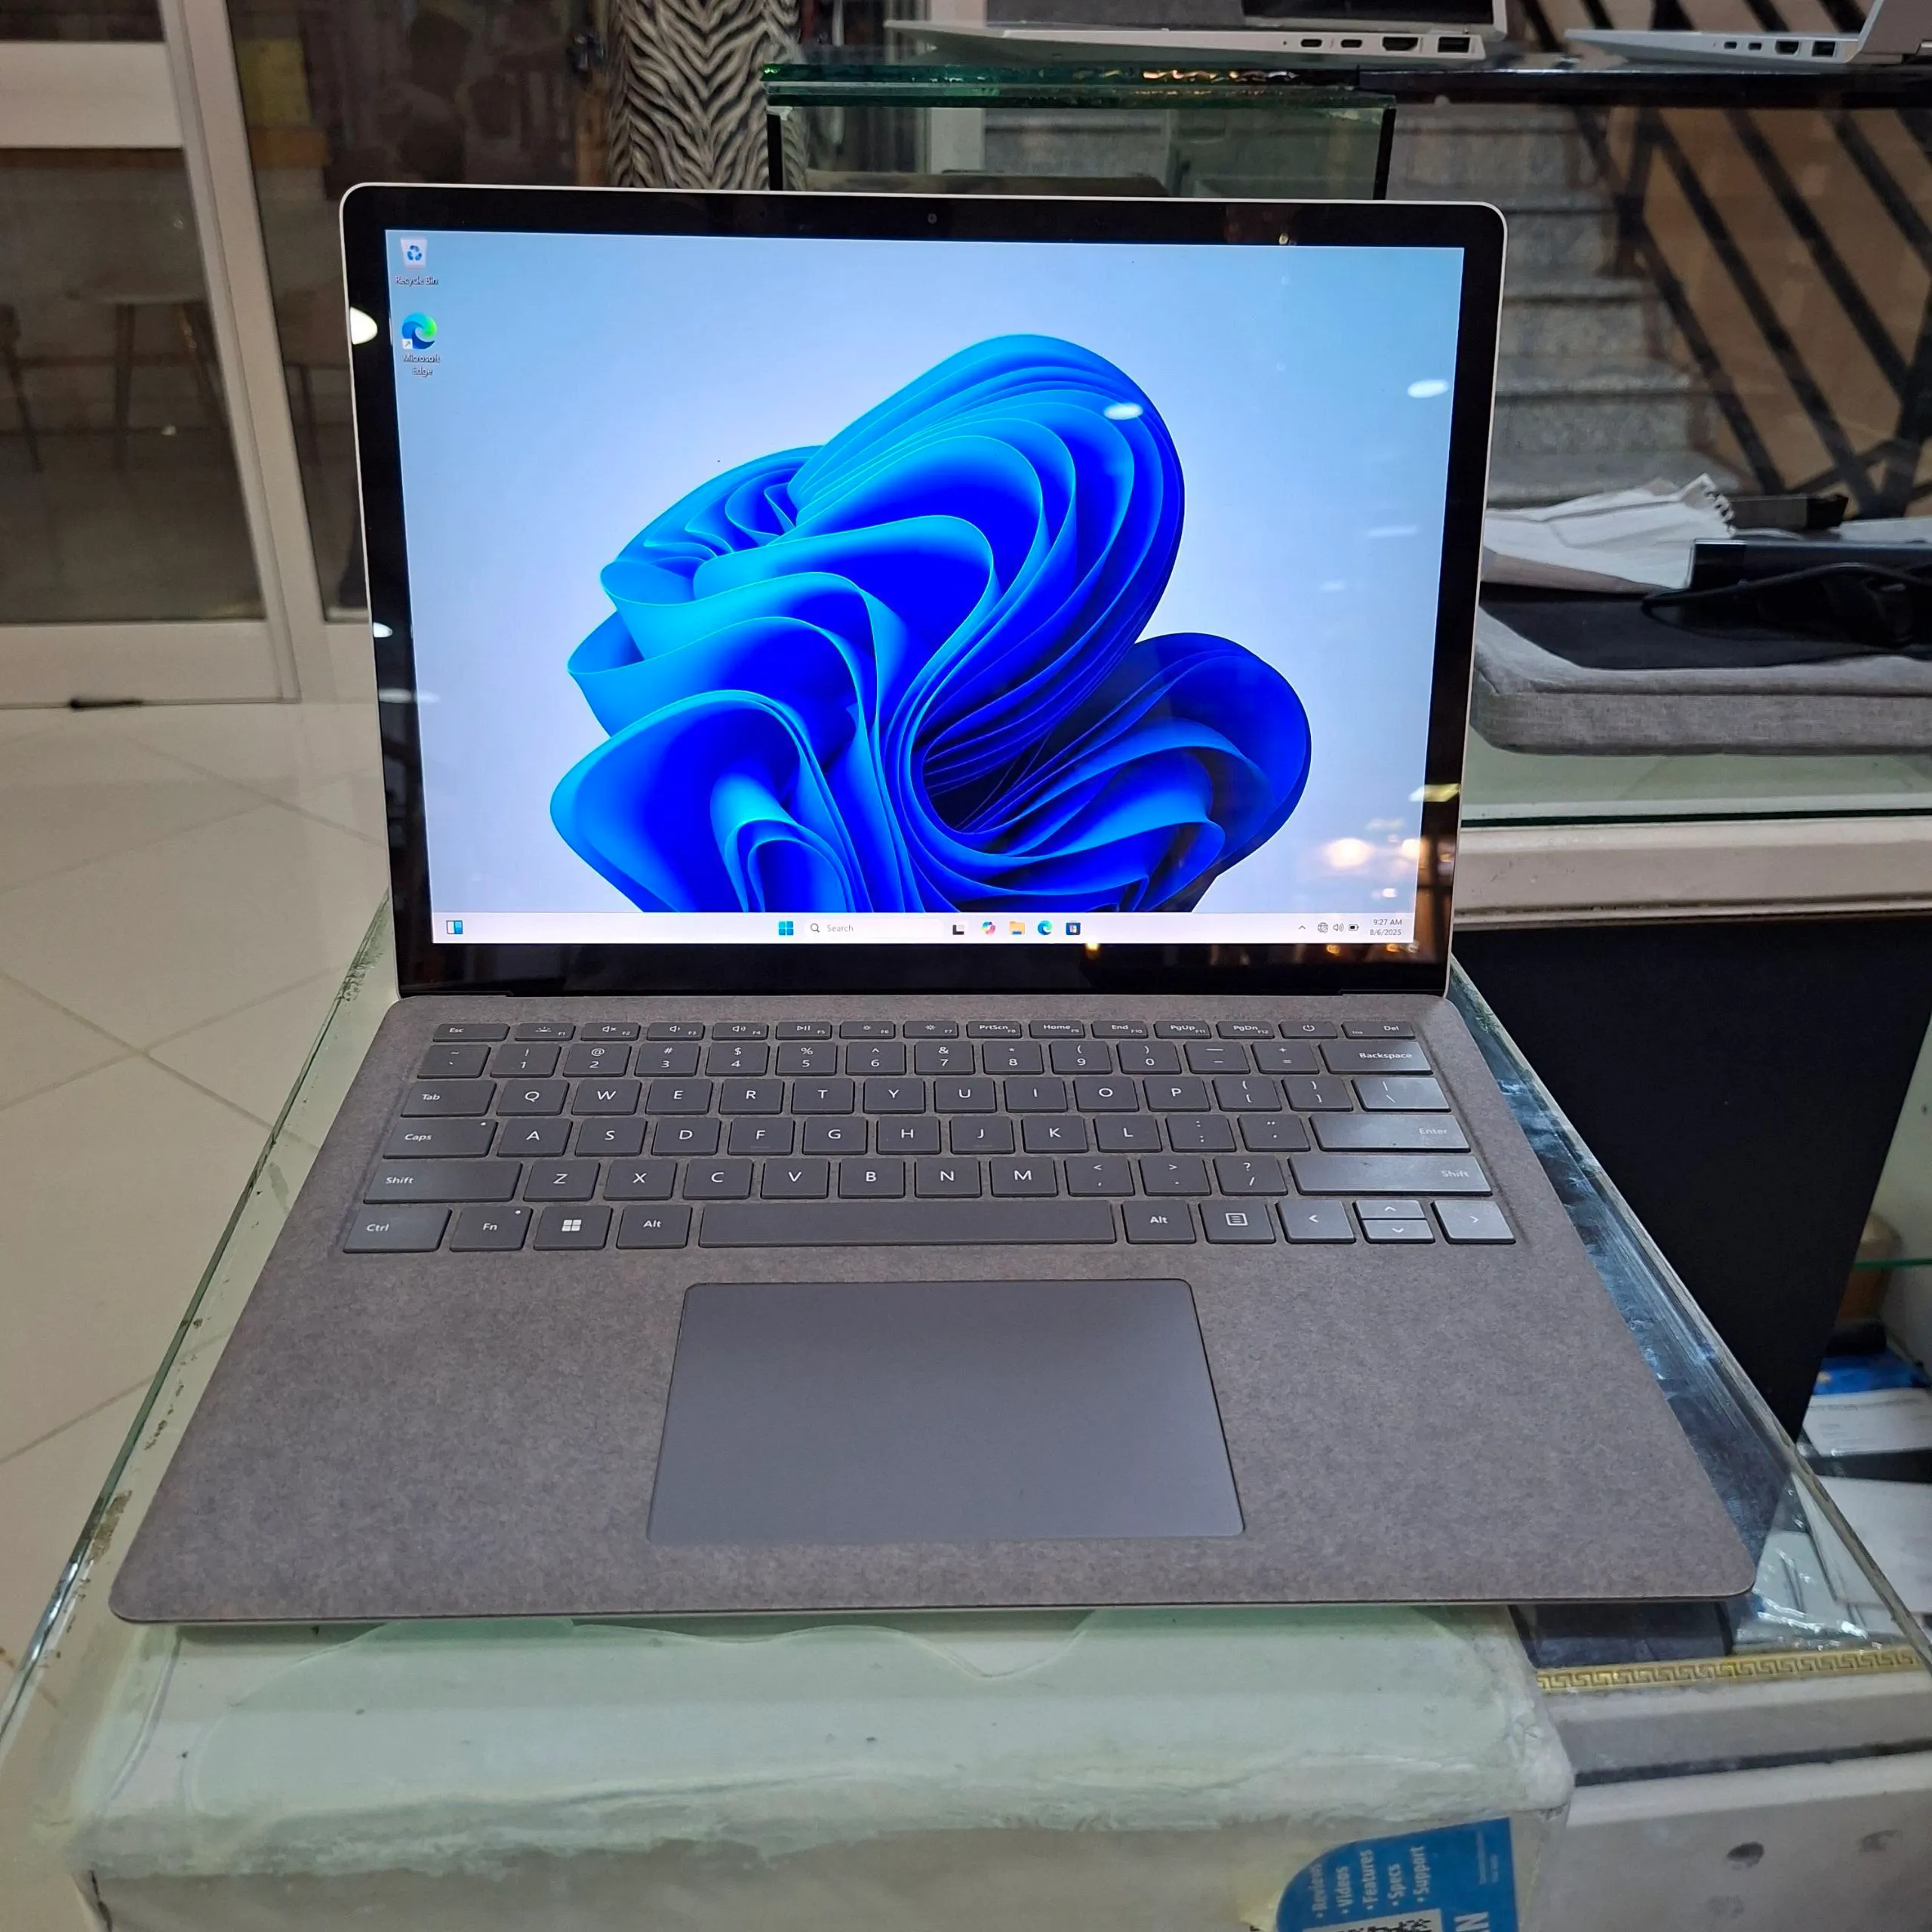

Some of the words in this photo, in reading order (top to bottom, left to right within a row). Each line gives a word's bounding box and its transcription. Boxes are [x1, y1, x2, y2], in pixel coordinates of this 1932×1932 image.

[395, 276, 423, 286] Recycle
[426, 277, 438, 285] Bin
[403, 354, 441, 362] Microsoft
[412, 368, 432, 377] Edge
[801, 1047, 814, 1055] %
[938, 1046, 949, 1054] &
[589, 1060, 599, 1069] 2
[802, 1060, 810, 1068] 5
[871, 1059, 880, 1067] 6
[1009, 1058, 1018, 1066] 8
[525, 1092, 539, 1102] Q
[598, 1091, 616, 1100] W
[674, 1091, 682, 1099] E
[746, 1091, 755, 1099] R
[889, 1090, 899, 1098] Y
[1099, 1088, 1112, 1097] O
[1171, 1088, 1181, 1097] P
[527, 1131, 539, 1140] A
[605, 1131, 614, 1140] S
[680, 1131, 692, 1139] D
[756, 1131, 765, 1139] F
[829, 1130, 841, 1139] G
[902, 1129, 913, 1138] H
[976, 1129, 985, 1139] J
[1050, 1128, 1060, 1137] K
[1124, 1128, 1133, 1137] L
[405, 1134, 432, 1142] Caps
[554, 1174, 568, 1183] Z
[633, 1174, 646, 1183] X
[712, 1172, 724, 1182] C
[789, 1172, 801, 1181] V
[866, 1172, 876, 1181] B
[941, 1171, 954, 1180] N
[1014, 1171, 1031, 1180] M
[643, 1220, 661, 1228] Alt
[1150, 1216, 1168, 1224] Alt
[366, 1223, 389, 1232] Ctrl
[482, 1223, 497, 1231] Fn
[1410, 1845, 1431, 1895] Support
[1360, 1849, 1379, 1903] Features
[1387, 1863, 1406, 1900] Specs
[1336, 1866, 1353, 1907] Videos
